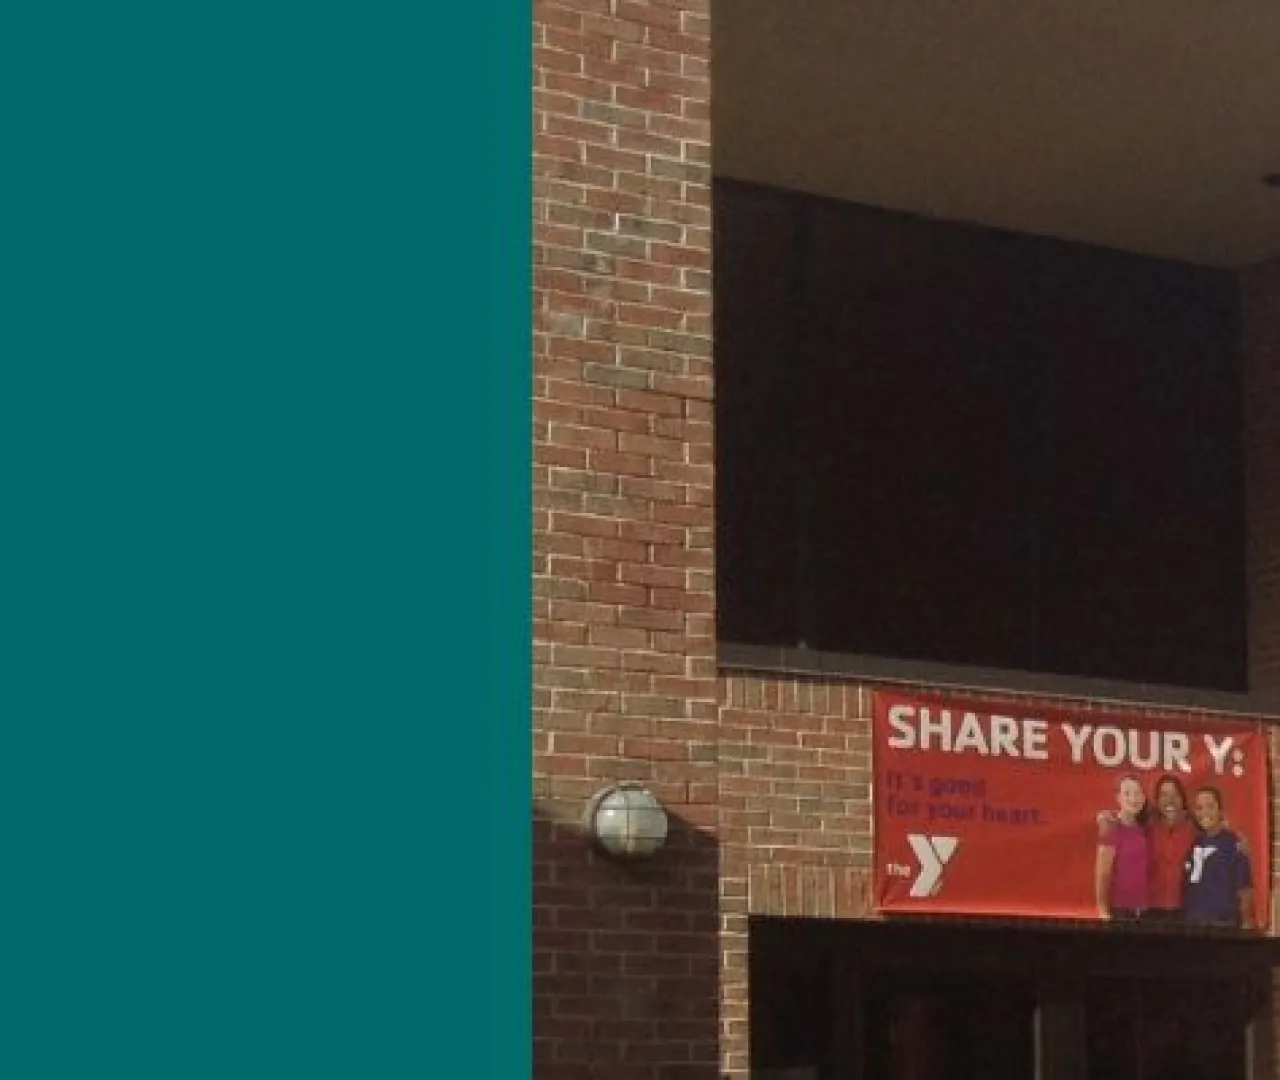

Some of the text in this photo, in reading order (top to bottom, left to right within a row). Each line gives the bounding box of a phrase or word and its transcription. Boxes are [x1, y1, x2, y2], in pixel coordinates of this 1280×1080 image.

[887, 703, 1245, 778] SHARE YOUR Y:
[929, 776, 986, 798] good
[926, 801, 975, 822] your
